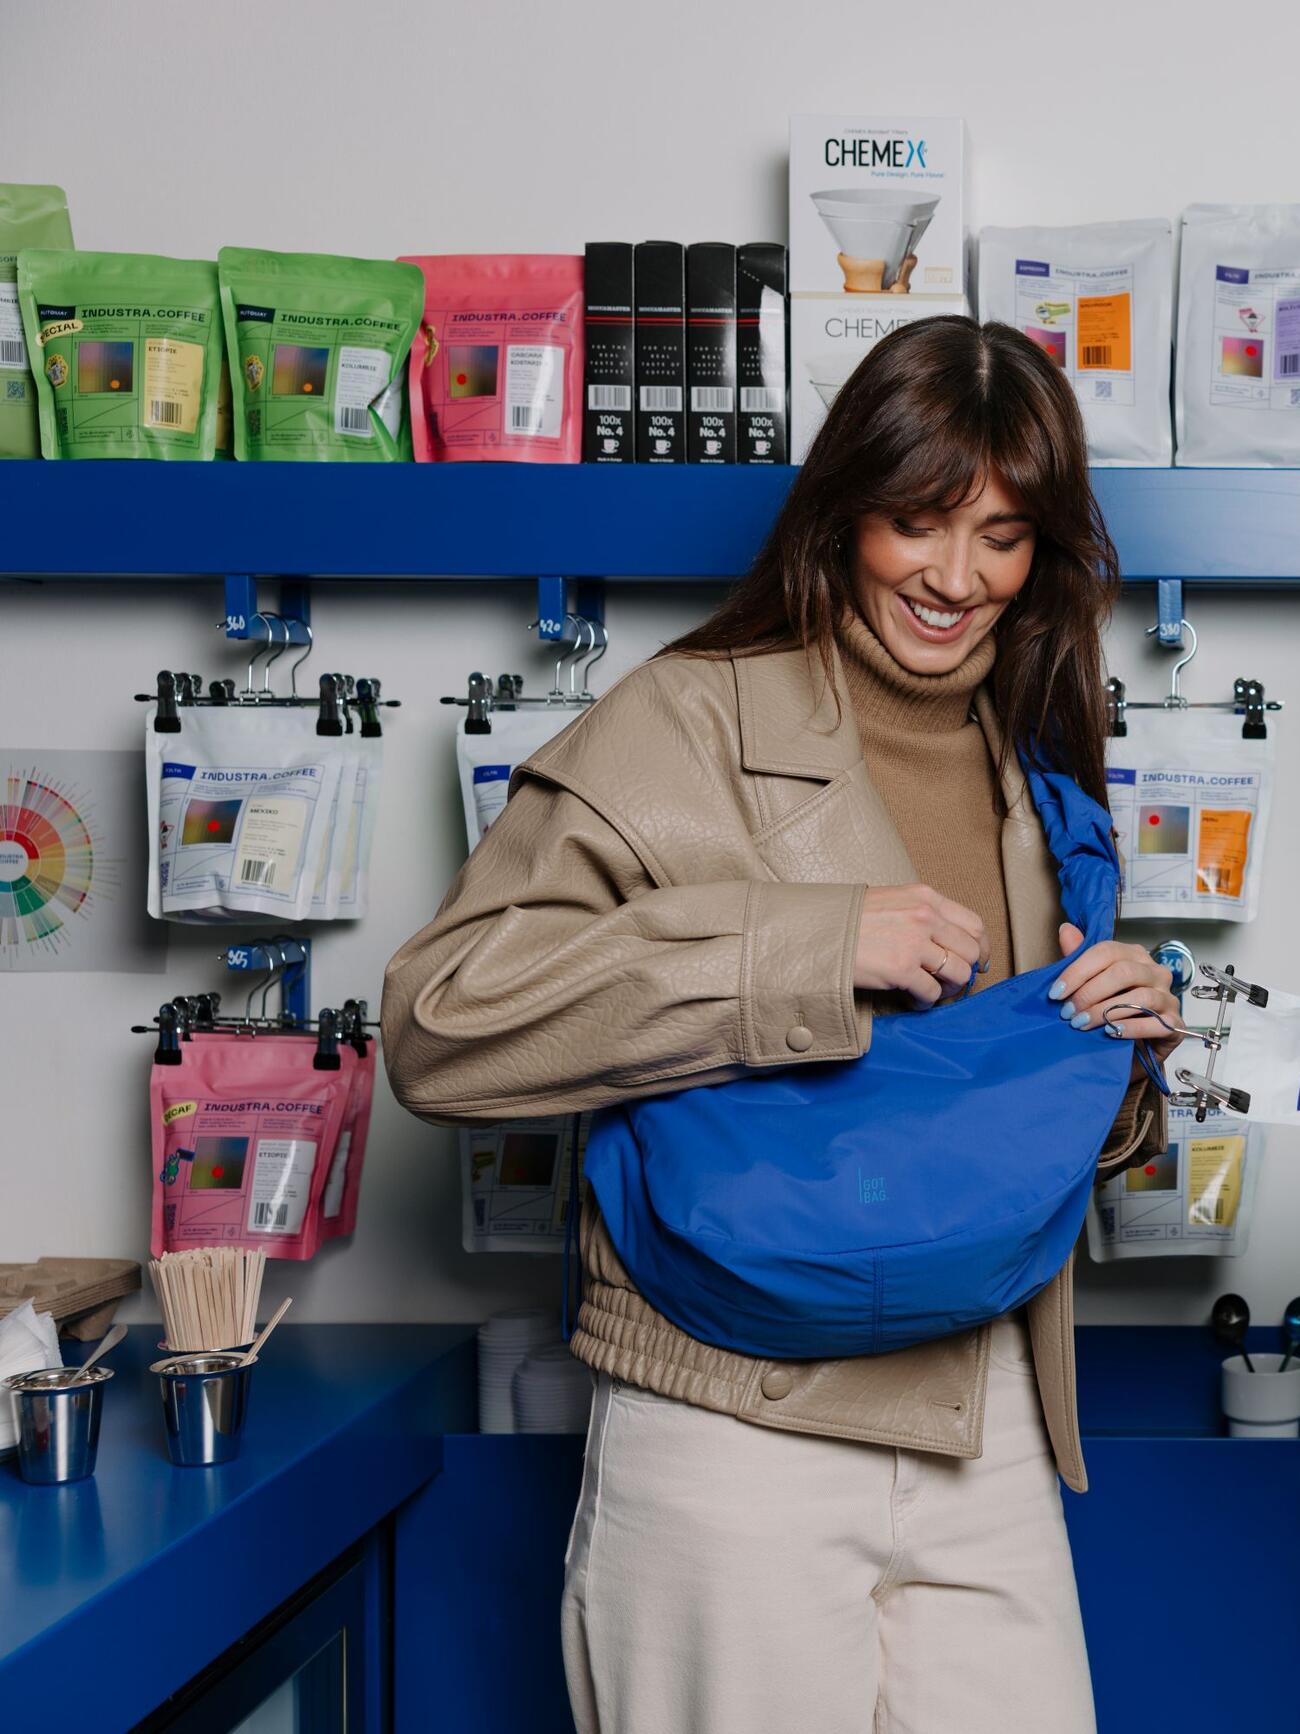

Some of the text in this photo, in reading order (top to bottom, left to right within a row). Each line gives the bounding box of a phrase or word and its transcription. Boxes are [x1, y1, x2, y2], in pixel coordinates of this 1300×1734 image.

[825, 138, 926, 168] CHEMEX
[81, 308, 205, 323] INDUSTRA.COFFEE
[452, 311, 567, 322] INDUSTRA.COFFEE
[281, 313, 401, 331] INDUSTRA.COFFEE
[825, 317, 916, 339] CHEM
[599, 415, 622, 426] 100x
[651, 415, 673, 426] 100x
[702, 416, 724, 427] 100x
[751, 416, 773, 427] 100x
[596, 426, 624, 436] No. 4
[648, 427, 675, 437] No. 4
[699, 427, 726, 437] No. 4
[749, 428, 775, 438] No. 4
[539, 619, 561, 633] 420
[201, 768, 317, 782] INDUSTRA.COFFEE
[1141, 773, 1254, 785] INDUSTRA.COFFEE
[204, 1102, 323, 1115] INDUSTRA.COFFEE
[258, 1151, 288, 1159] ETIOPIE
[863, 1176, 885, 1191] GOT
[863, 1190, 887, 1204] BAG
